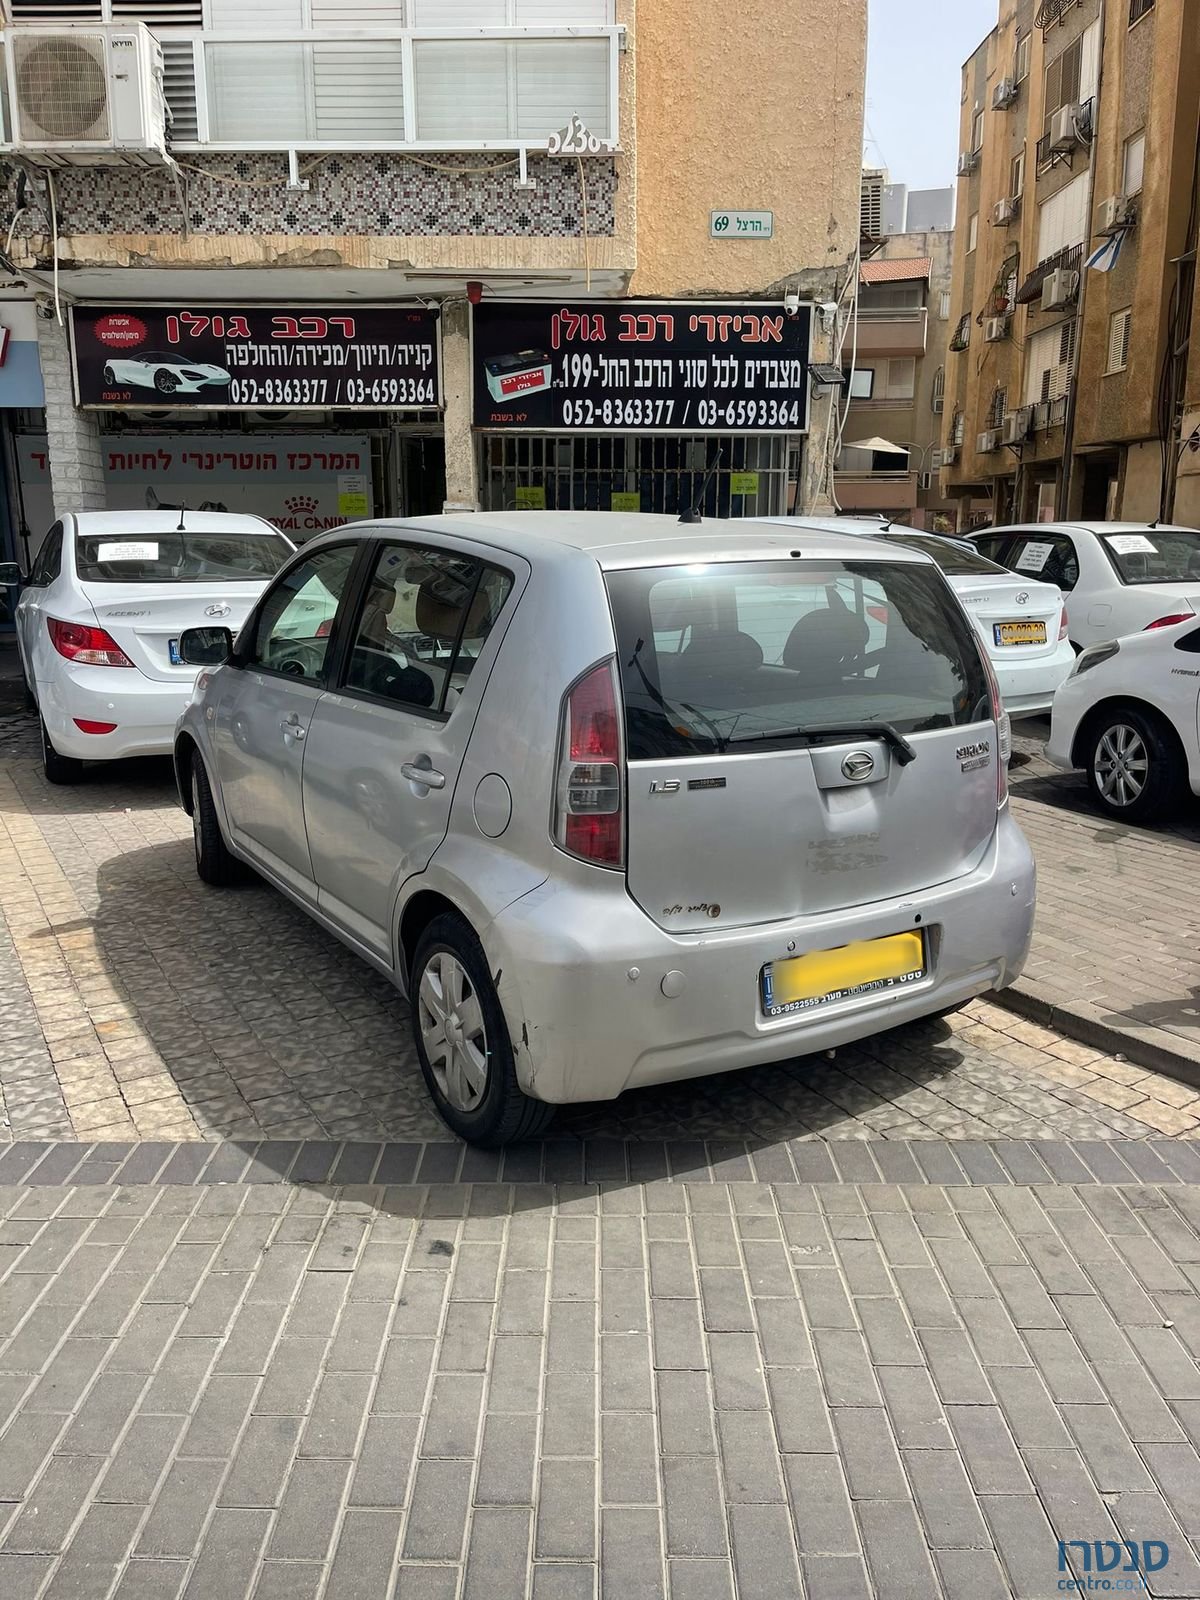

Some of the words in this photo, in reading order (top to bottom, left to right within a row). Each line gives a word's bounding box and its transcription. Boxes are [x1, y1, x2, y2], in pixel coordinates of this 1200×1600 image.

[714, 215, 730, 231] 69
[736, 216, 762, 231] הרצל
[166, 311, 252, 344] גולן
[271, 316, 356, 339] רכב
[551, 308, 607, 350] גולן
[618, 314, 675, 342] רכב
[689, 314, 784, 343] אביזרי
[501, 377, 517, 385] רכב
[518, 370, 543, 381] אביזרי
[634, 358, 673, 389] הרכב
[678, 358, 708, 389] סוגי
[712, 354, 739, 389] לכל
[744, 358, 800, 389] מצברים
[122, 391, 132, 400] לא
[231, 379, 328, 404] 052-8363377
[347, 378, 434, 403] 03-6593364
[517, 382, 532, 390] גולן
[102, 392, 121, 400] בשבת
[491, 413, 514, 422] בשבת
[516, 412, 528, 422] לא
[562, 398, 675, 425] 052-8363377
[698, 399, 799, 425] 03-6593364
[108, 449, 172, 470] לחיות
[182, 452, 277, 470] הוטרינרי
[287, 452, 360, 470] המרכז
[268, 516, 301, 530] OYAL
[304, 516, 348, 530] CANIN
[956, 741, 990, 760] SIRION
[770, 996, 820, 1015] 03-9522555
